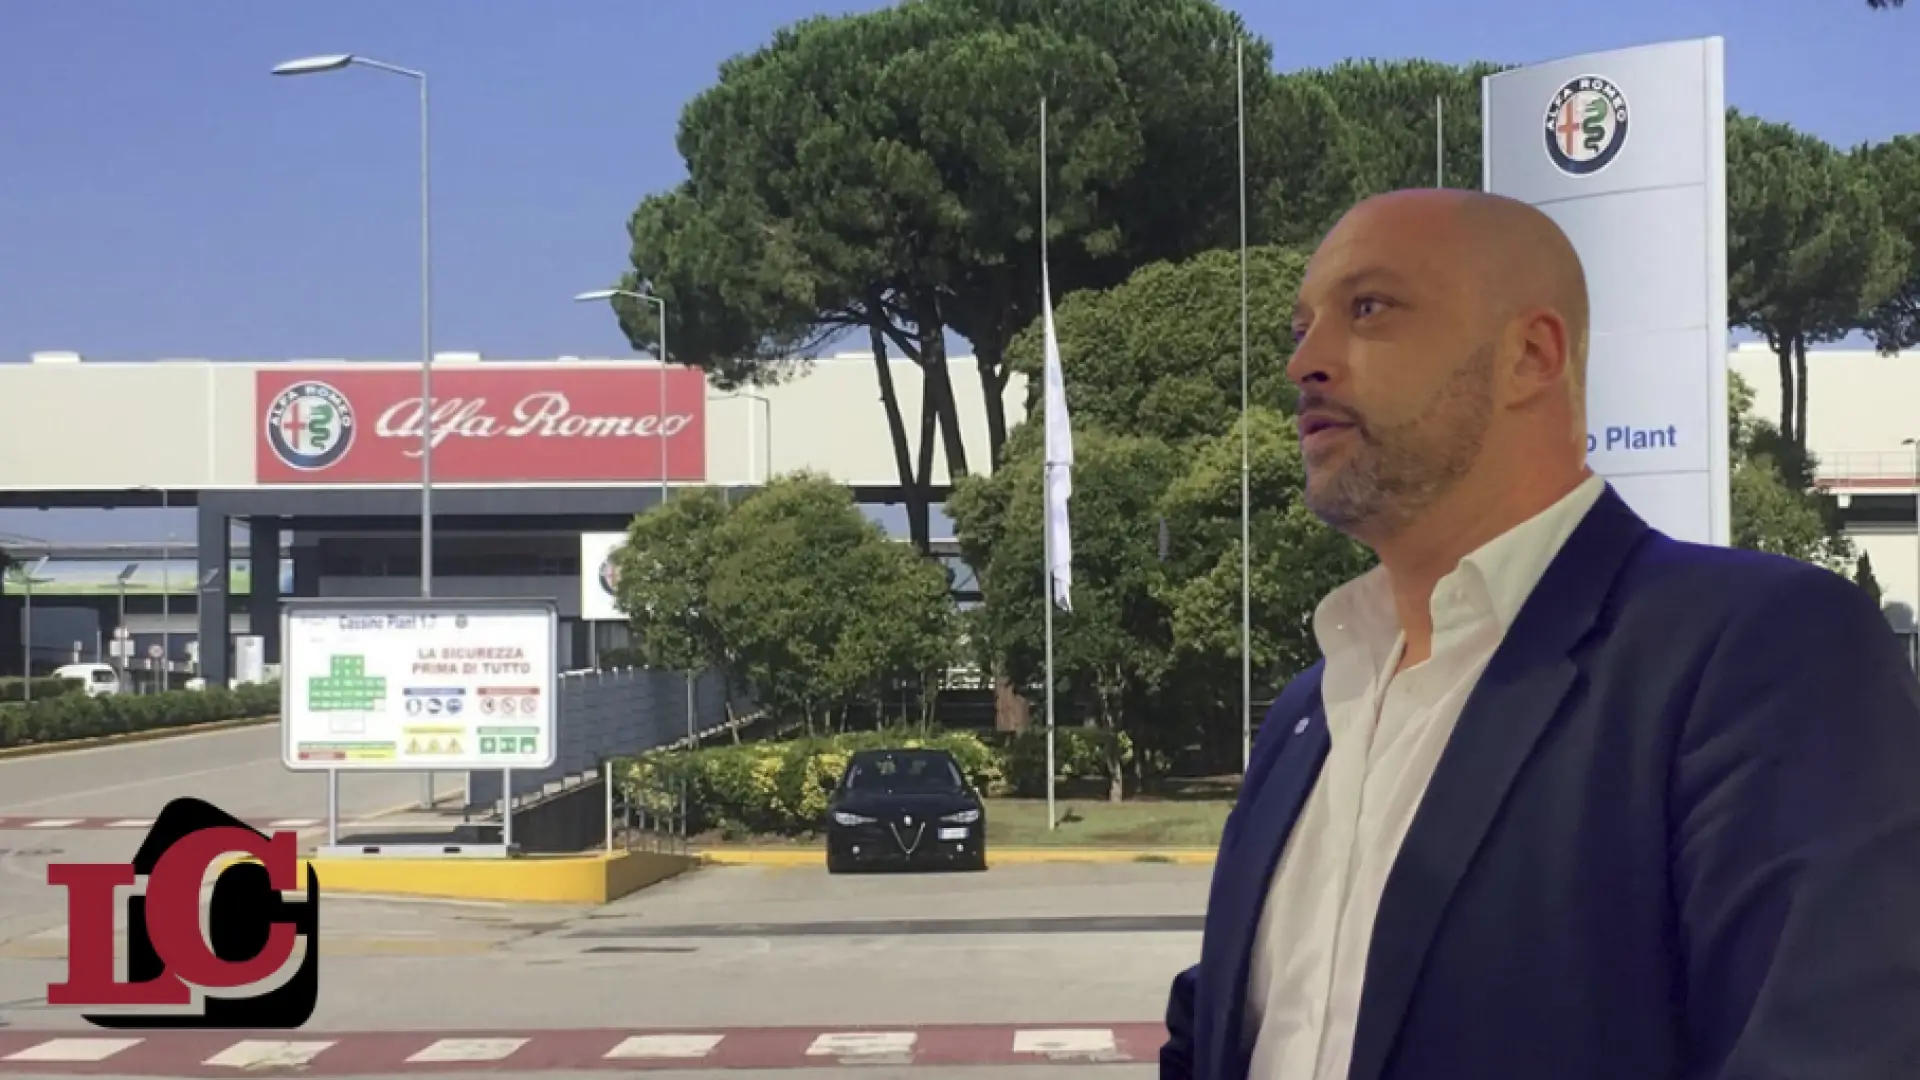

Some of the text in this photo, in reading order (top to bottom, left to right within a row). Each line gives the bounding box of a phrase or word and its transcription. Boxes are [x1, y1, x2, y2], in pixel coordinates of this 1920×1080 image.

[1580, 79, 1627, 122] ROMEO
[375, 391, 694, 457] Alfa Romeo
[1605, 424, 1678, 452] Plant
[418, 647, 524, 660] LA SICUREZZA
[412, 662, 531, 675] PRIMA DI TUTTO
